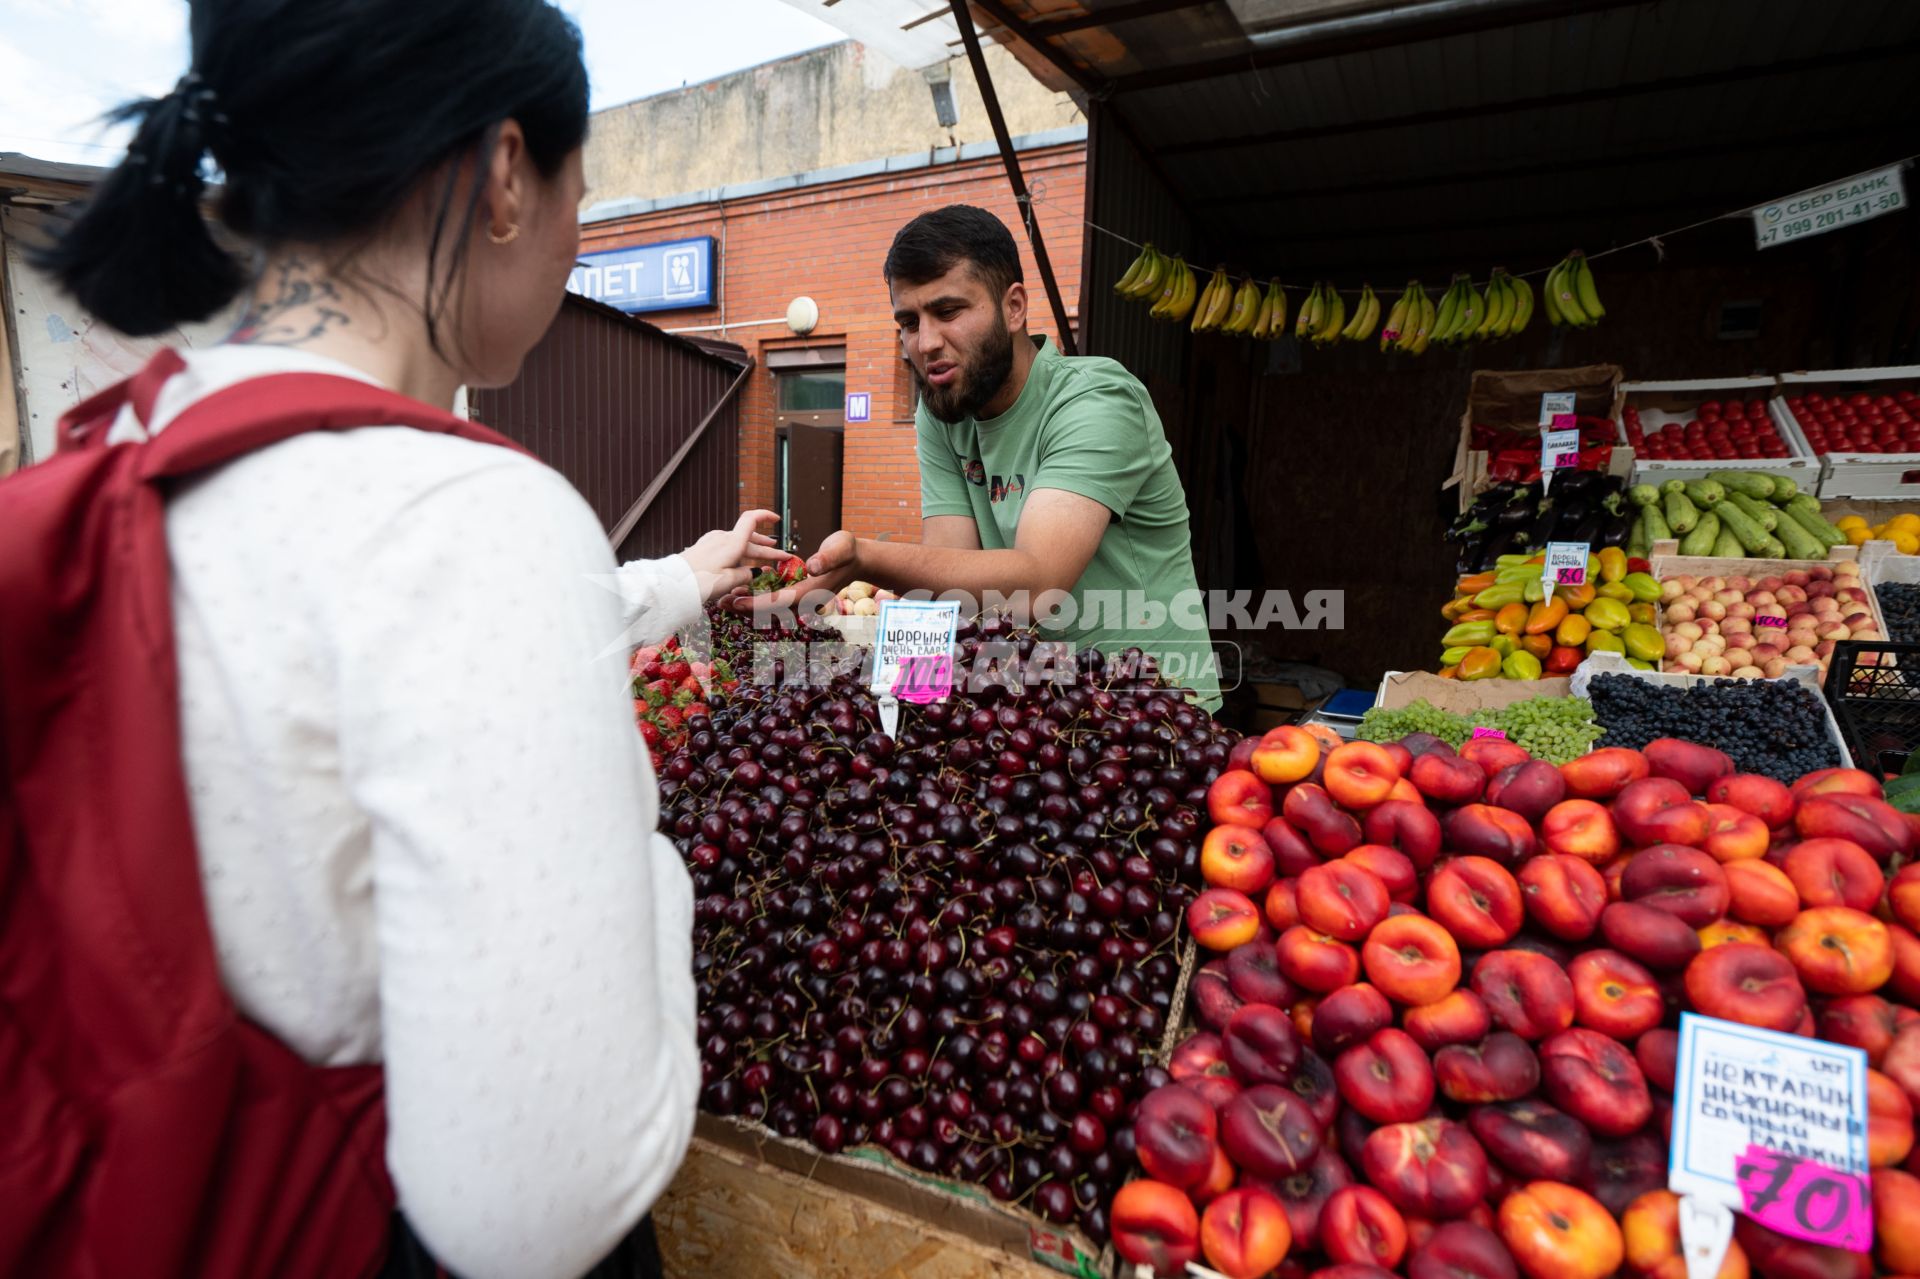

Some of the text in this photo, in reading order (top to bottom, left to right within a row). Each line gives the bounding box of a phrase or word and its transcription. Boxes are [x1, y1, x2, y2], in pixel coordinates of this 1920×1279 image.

[1760, 192, 1900, 243] +7 999 201-41-50
[849, 396, 867, 418] М
[1558, 568, 1584, 584] 80
